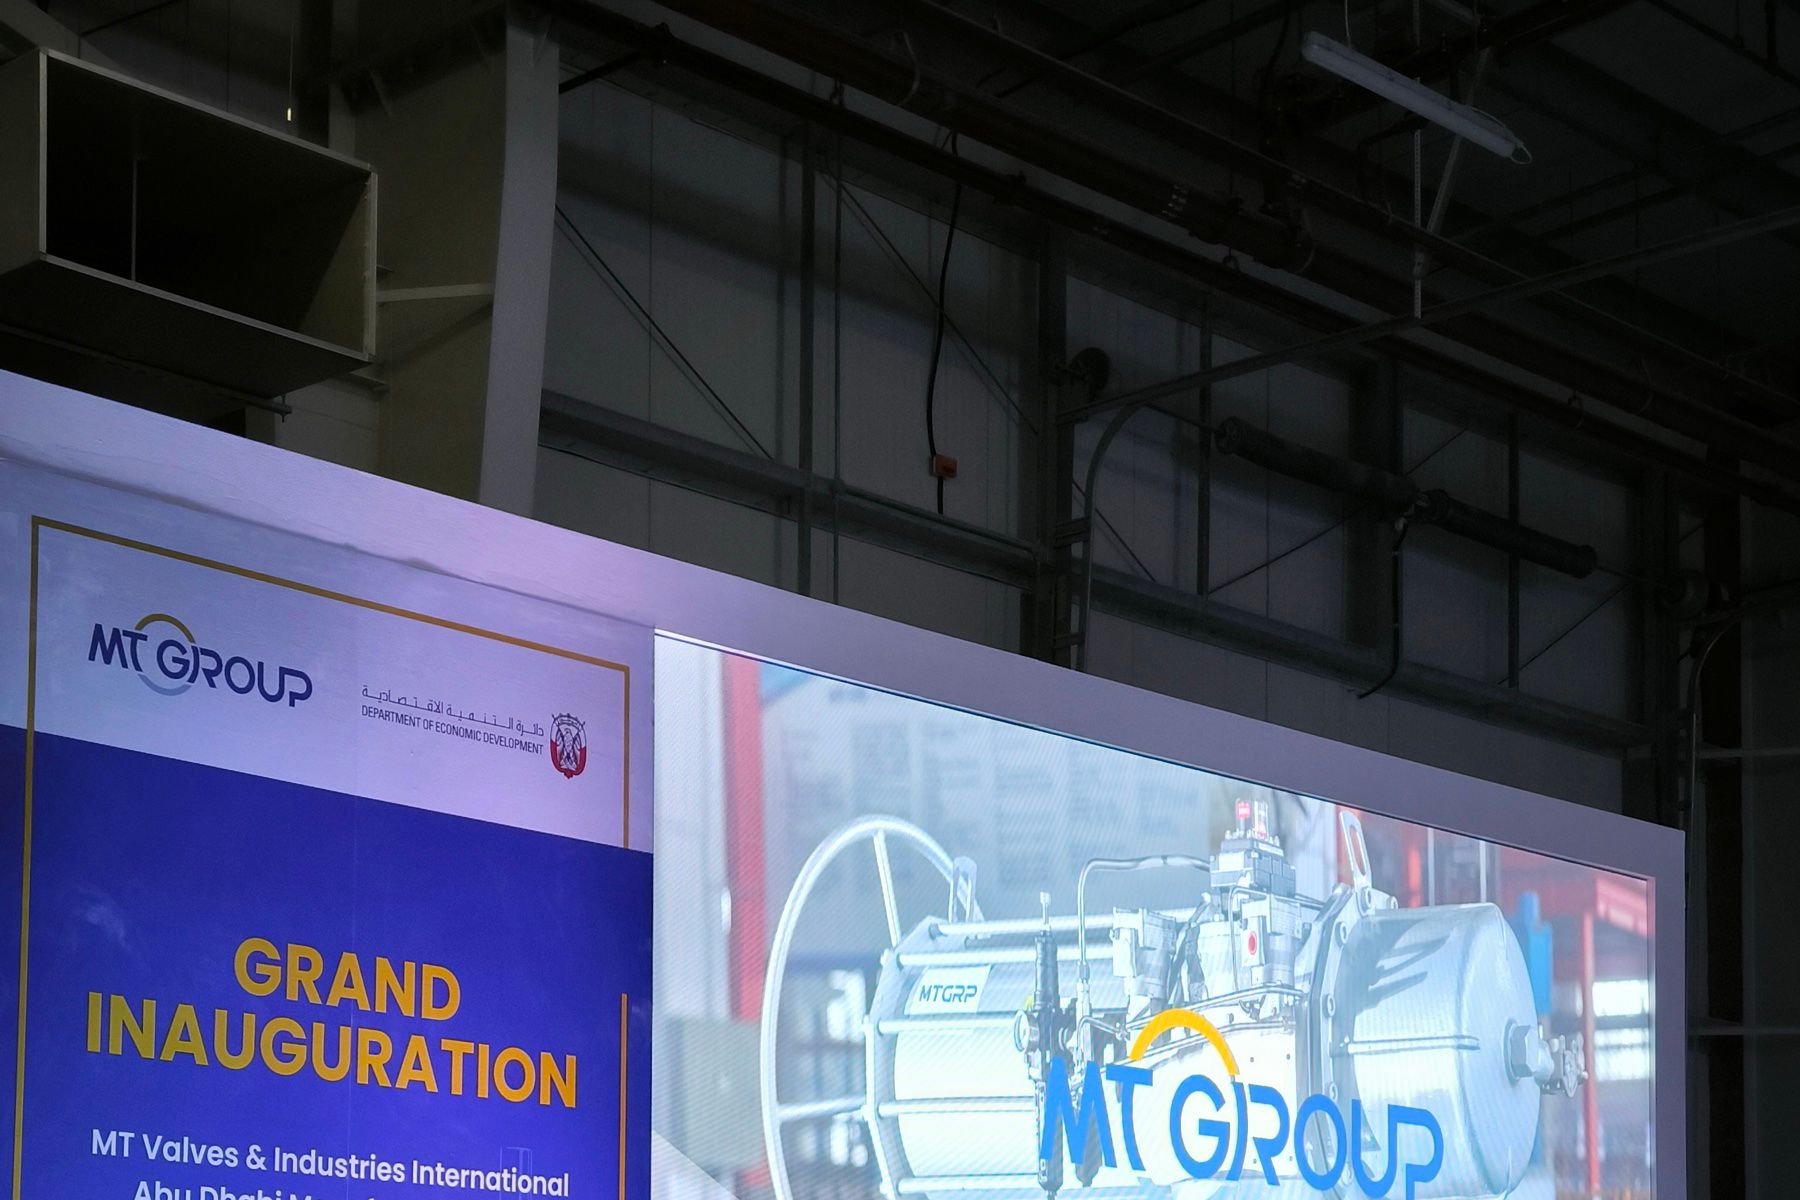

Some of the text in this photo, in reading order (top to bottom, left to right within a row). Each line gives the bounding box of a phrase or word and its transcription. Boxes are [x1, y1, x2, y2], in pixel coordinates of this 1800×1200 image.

[88, 624, 313, 707] MT GROUP
[361, 704, 543, 755] DEPARTMENT OF ECONOMIC DEVELOPMENT
[362, 684, 544, 737] دائرة التنمية الاقتصادية
[233, 937, 460, 1021] GRAND
[918, 985, 978, 1003] MTGRP
[86, 991, 577, 1109] INAUGURATION
[1039, 1055, 1153, 1171] MT
[91, 1129, 569, 1197] MT Valves & Industries International
